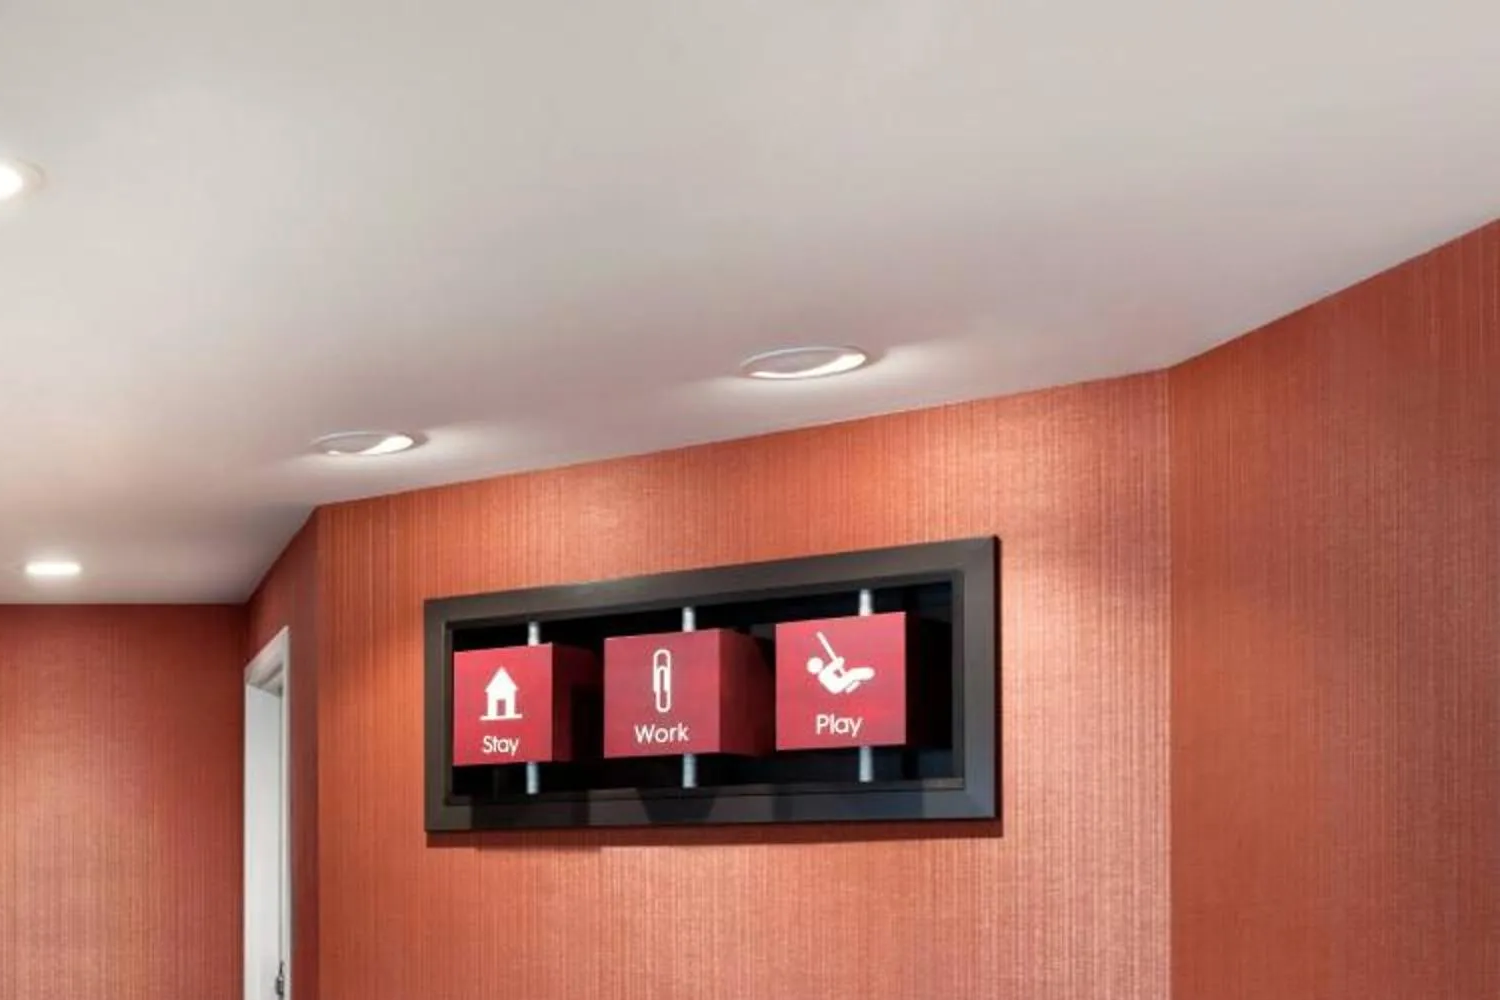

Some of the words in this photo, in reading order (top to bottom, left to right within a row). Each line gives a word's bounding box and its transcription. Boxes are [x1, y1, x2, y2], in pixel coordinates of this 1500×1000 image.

[634, 722, 690, 744] Work
[815, 712, 863, 738] Play
[483, 735, 519, 756] Stay
